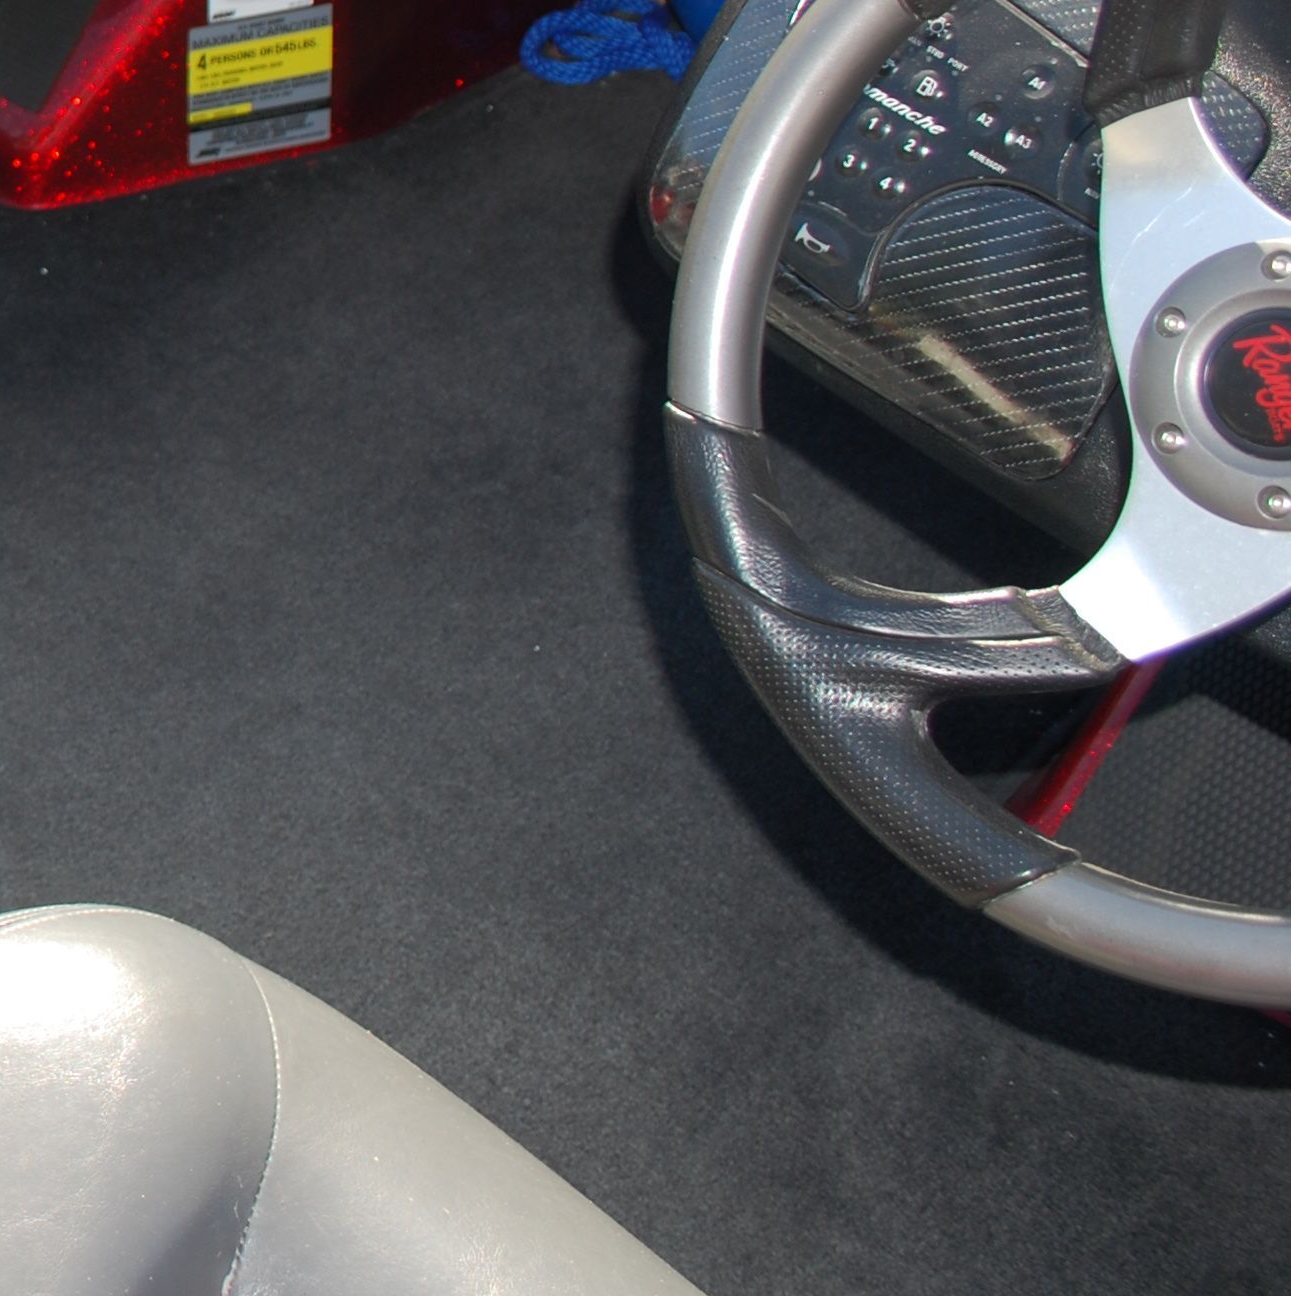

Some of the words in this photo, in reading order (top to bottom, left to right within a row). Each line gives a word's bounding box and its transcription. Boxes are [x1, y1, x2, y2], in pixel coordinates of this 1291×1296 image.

[197, 53, 208, 71] 4
[947, 57, 969, 72] PORT
[862, 83, 947, 135] manche
[868, 117, 879, 131] 1
[975, 112, 995, 128] A2
[903, 138, 917, 153] 2
[1015, 134, 1033, 150] A3
[842, 154, 856, 168] 3
[879, 176, 894, 191] 4
